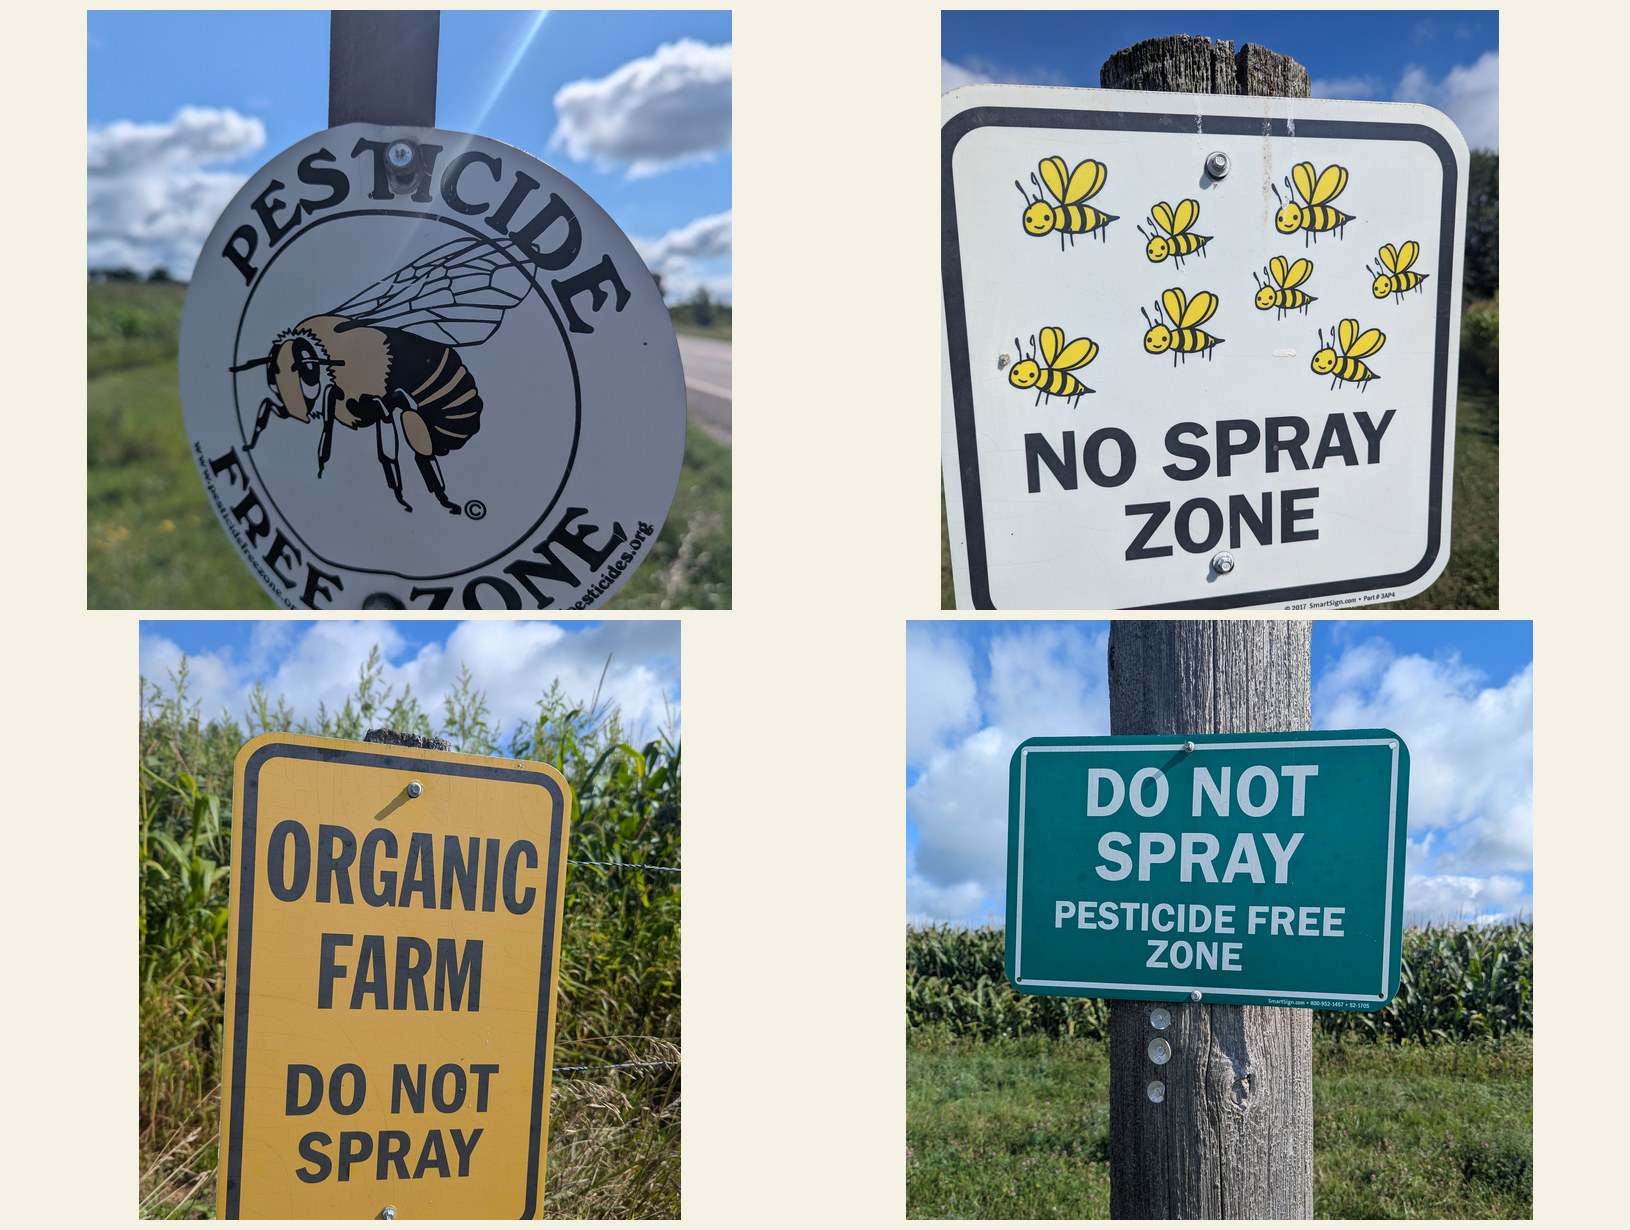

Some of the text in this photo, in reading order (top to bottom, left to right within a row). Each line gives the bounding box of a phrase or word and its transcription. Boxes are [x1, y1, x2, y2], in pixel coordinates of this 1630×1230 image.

[221, 137, 632, 335] PESTICIDE
[1024, 409, 1397, 494] NO SPRAY
[208, 444, 628, 610] FREE ZONE
[1125, 487, 1319, 561] ZONE
[566, 520, 655, 610] esticides.org
[1309, 597, 1356, 608] SmartSign.com
[1363, 594, 1375, 602] Part
[1381, 592, 1396, 600] 3AP4
[1087, 765, 1319, 818] DO NOT
[267, 820, 538, 915] ORGANIC
[1095, 831, 1305, 884] SPRAY
[1055, 901, 1345, 937] PESTICIDE FREE
[317, 933, 484, 1012] FARM
[1146, 940, 1243, 972] ZONE
[1268, 998, 1305, 1006] SmartSign.com
[285, 1064, 499, 1116] DO NOT
[295, 1129, 485, 1183] SPRAY
